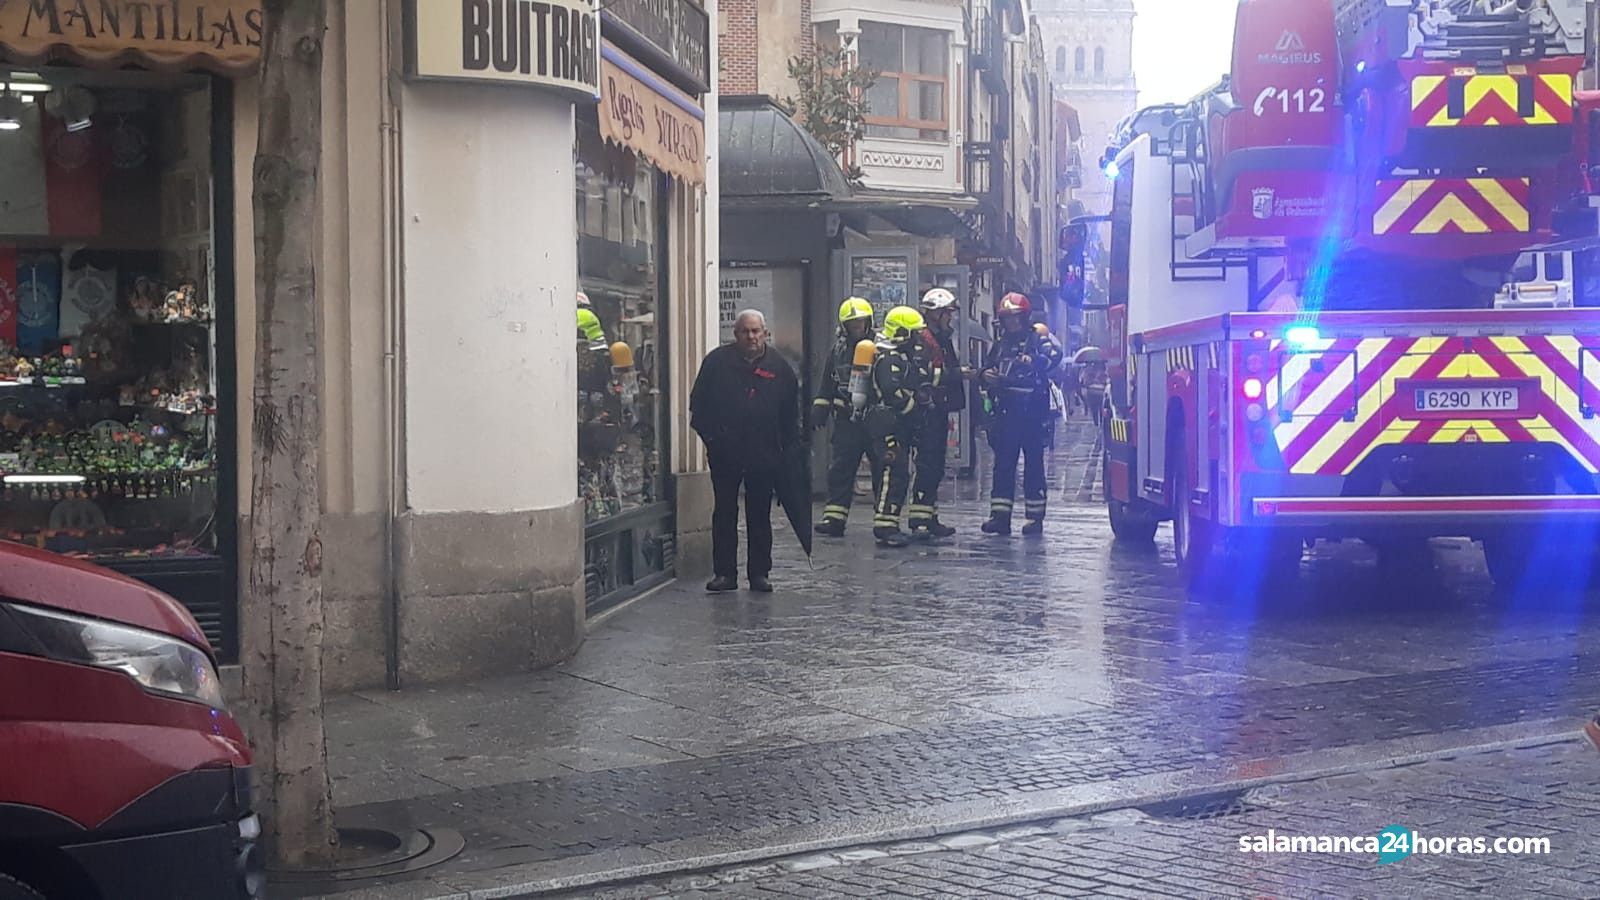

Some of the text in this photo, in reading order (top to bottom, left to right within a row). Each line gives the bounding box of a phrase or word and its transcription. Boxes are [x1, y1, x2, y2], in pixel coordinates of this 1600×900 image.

[22, 0, 262, 49] MANTILLAS
[1257, 52, 1321, 65] MAGIRUS
[1276, 88, 1325, 113] 112
[1428, 391, 1513, 408] 6290 KYP
